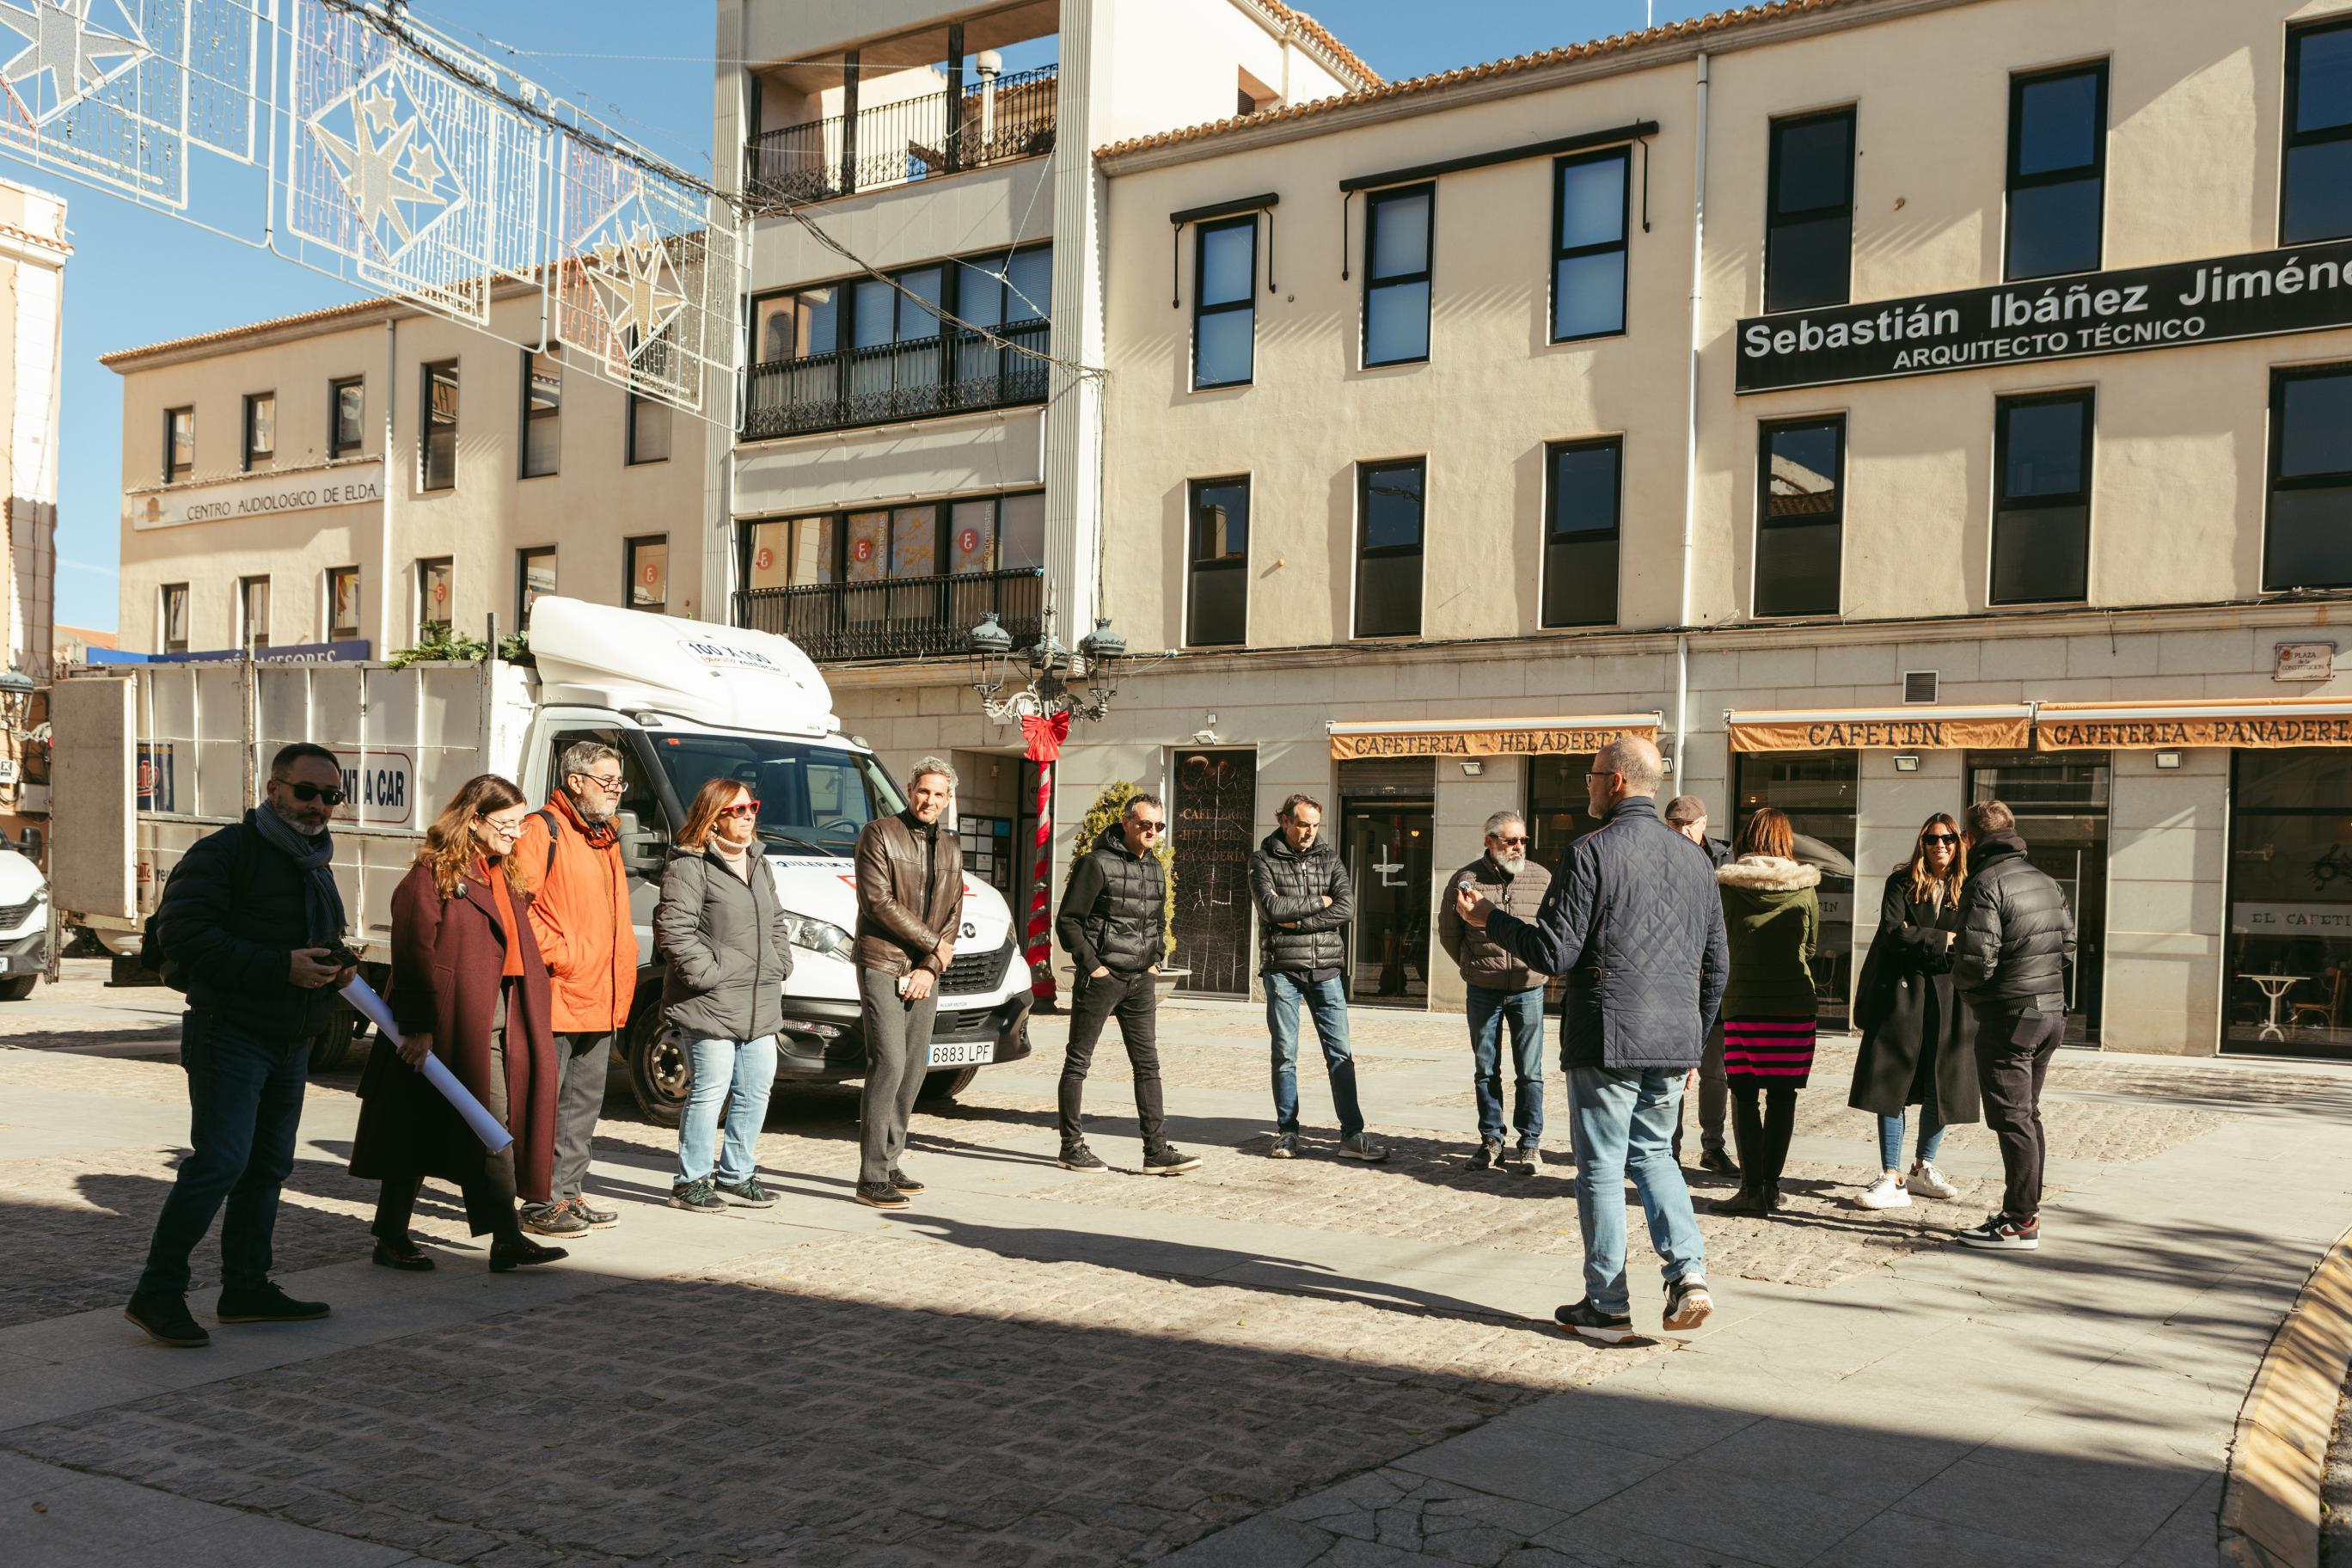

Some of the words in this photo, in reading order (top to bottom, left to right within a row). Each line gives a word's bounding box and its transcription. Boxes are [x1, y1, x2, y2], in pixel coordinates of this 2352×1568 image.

[1744, 303, 1959, 358] Sebastián
[1991, 284, 2149, 328] Ibáñez
[1893, 331, 2068, 370] ARQUITECTO
[2076, 315, 2206, 348] TÉCNICO
[187, 501, 231, 521] CENTRO
[238, 490, 316, 512] AUDIOLOGICO
[323, 487, 340, 503] DE
[346, 483, 377, 501] ELDA
[689, 642, 723, 655] 100
[1808, 721, 1941, 747] CAFETIN
[2054, 722, 2189, 744] CAFETERIA
[2214, 720, 2352, 744] PANADERI
[1355, 735, 1468, 755] CAFETERIA
[377, 769, 404, 806] CAR
[2252, 913, 2276, 923] EL
[933, 1046, 964, 1063] 6883
[969, 1044, 990, 1062] LPF
